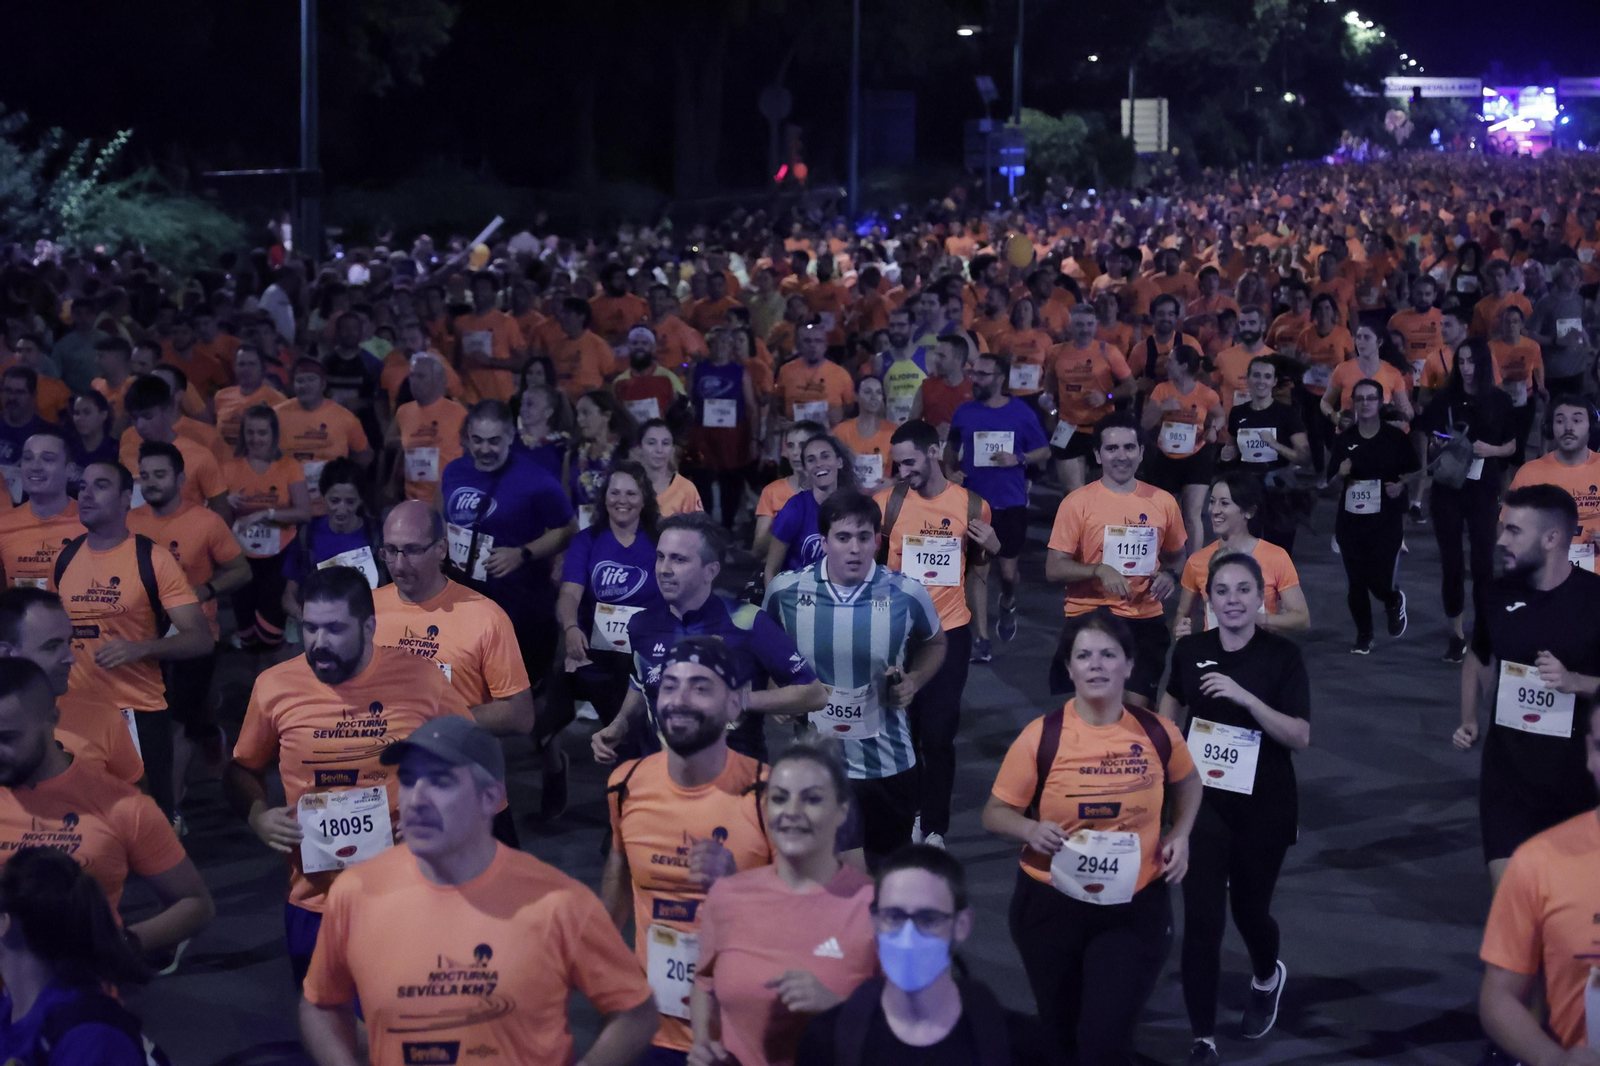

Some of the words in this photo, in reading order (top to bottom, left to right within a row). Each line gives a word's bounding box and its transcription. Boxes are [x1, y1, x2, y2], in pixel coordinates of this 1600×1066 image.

[1169, 432, 1186, 441] 9853
[985, 443, 1004, 452] 7991
[456, 493, 481, 510] life
[1351, 491, 1371, 500] 9353
[1117, 543, 1148, 556] 11115
[916, 552, 950, 566] 17822
[601, 567, 629, 586] life
[86, 588, 122, 596] NOCTURNA
[70, 595, 100, 603] SEVILLA
[606, 621, 630, 635] 177
[398, 638, 440, 649] NOCTURNA
[1518, 687, 1555, 708] 9350
[826, 703, 862, 719] 3654
[336, 719, 388, 728] NOCTURNA
[313, 730, 359, 738] SEVILLA
[1203, 743, 1239, 764] 9349
[1100, 759, 1149, 767] NOCTURNA
[1079, 766, 1122, 775] SEVILLA
[319, 814, 374, 838] 18095
[22, 833, 83, 842] NOCTURNA
[651, 854, 691, 868] SEVILL
[1077, 855, 1119, 875] 2944
[428, 970, 498, 982] NOCTURNA
[397, 985, 458, 998] SEVILLA
